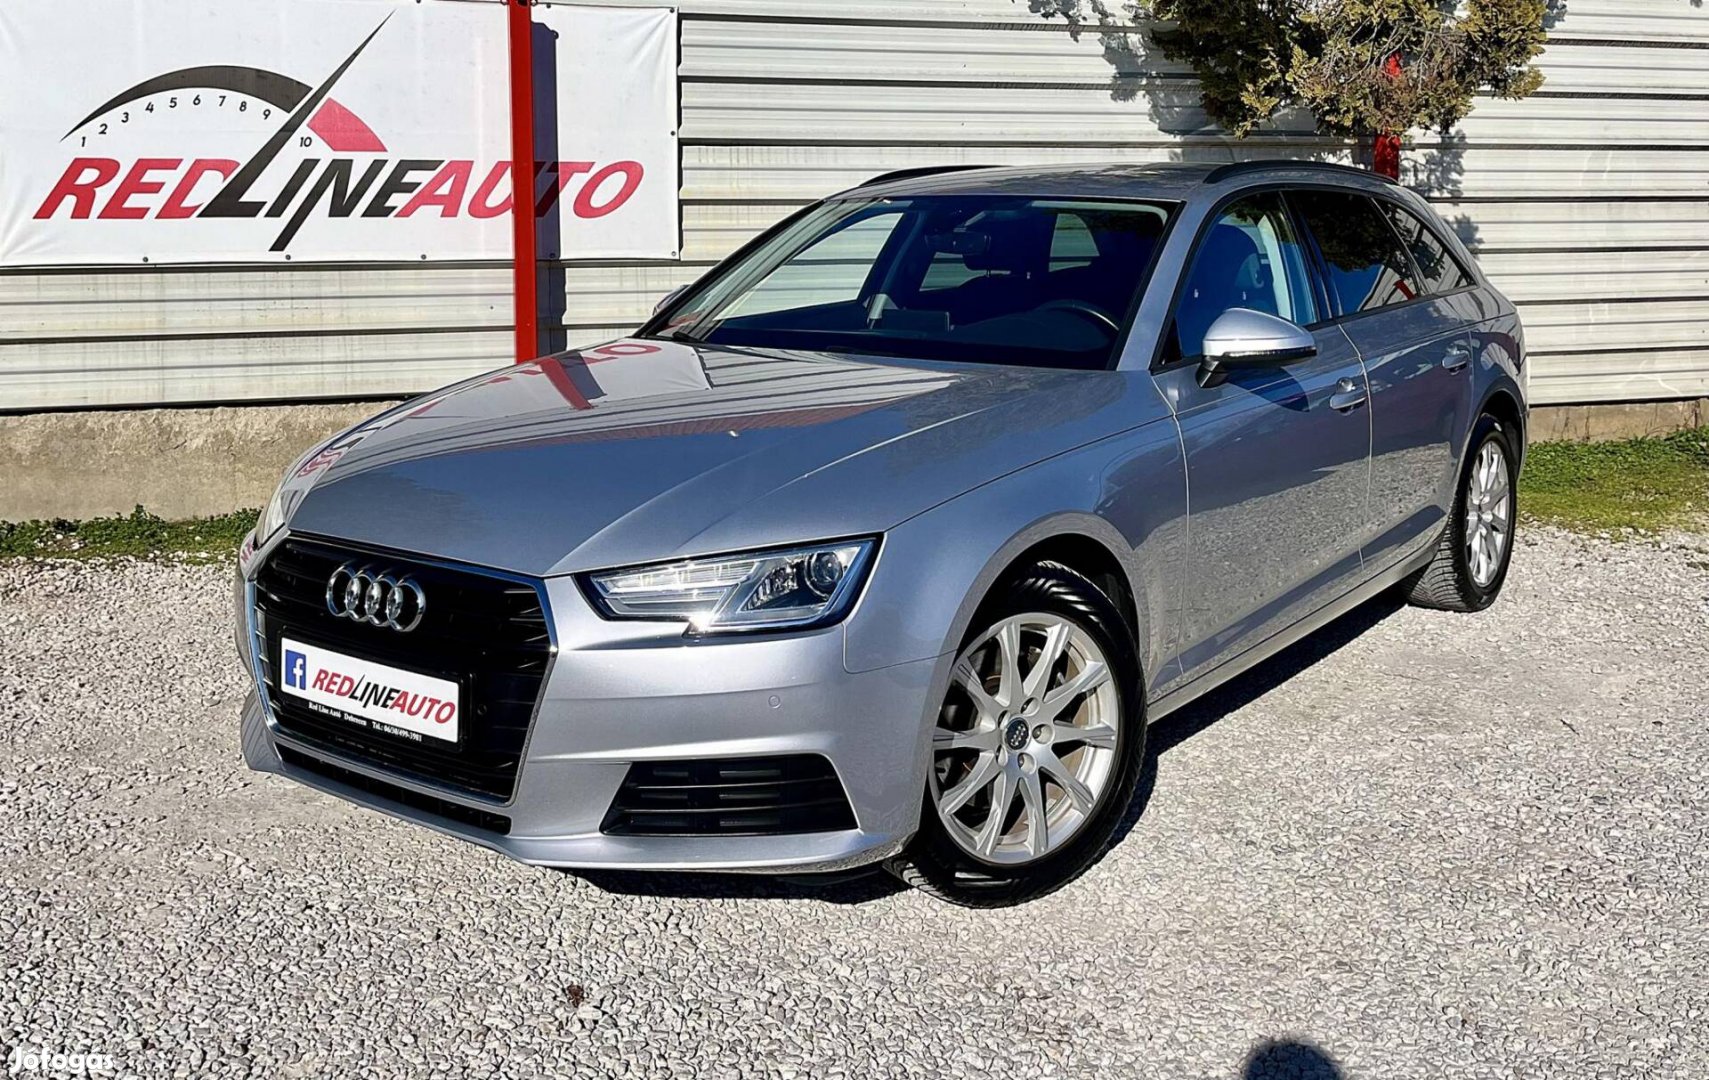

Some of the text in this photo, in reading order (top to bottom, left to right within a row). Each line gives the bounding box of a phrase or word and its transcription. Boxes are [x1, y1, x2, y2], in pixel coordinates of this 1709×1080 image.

[80, 94, 313, 148] 1 2 3 4 5 6 7 8 9 10
[311, 668, 456, 725] REDLINEAUTO
